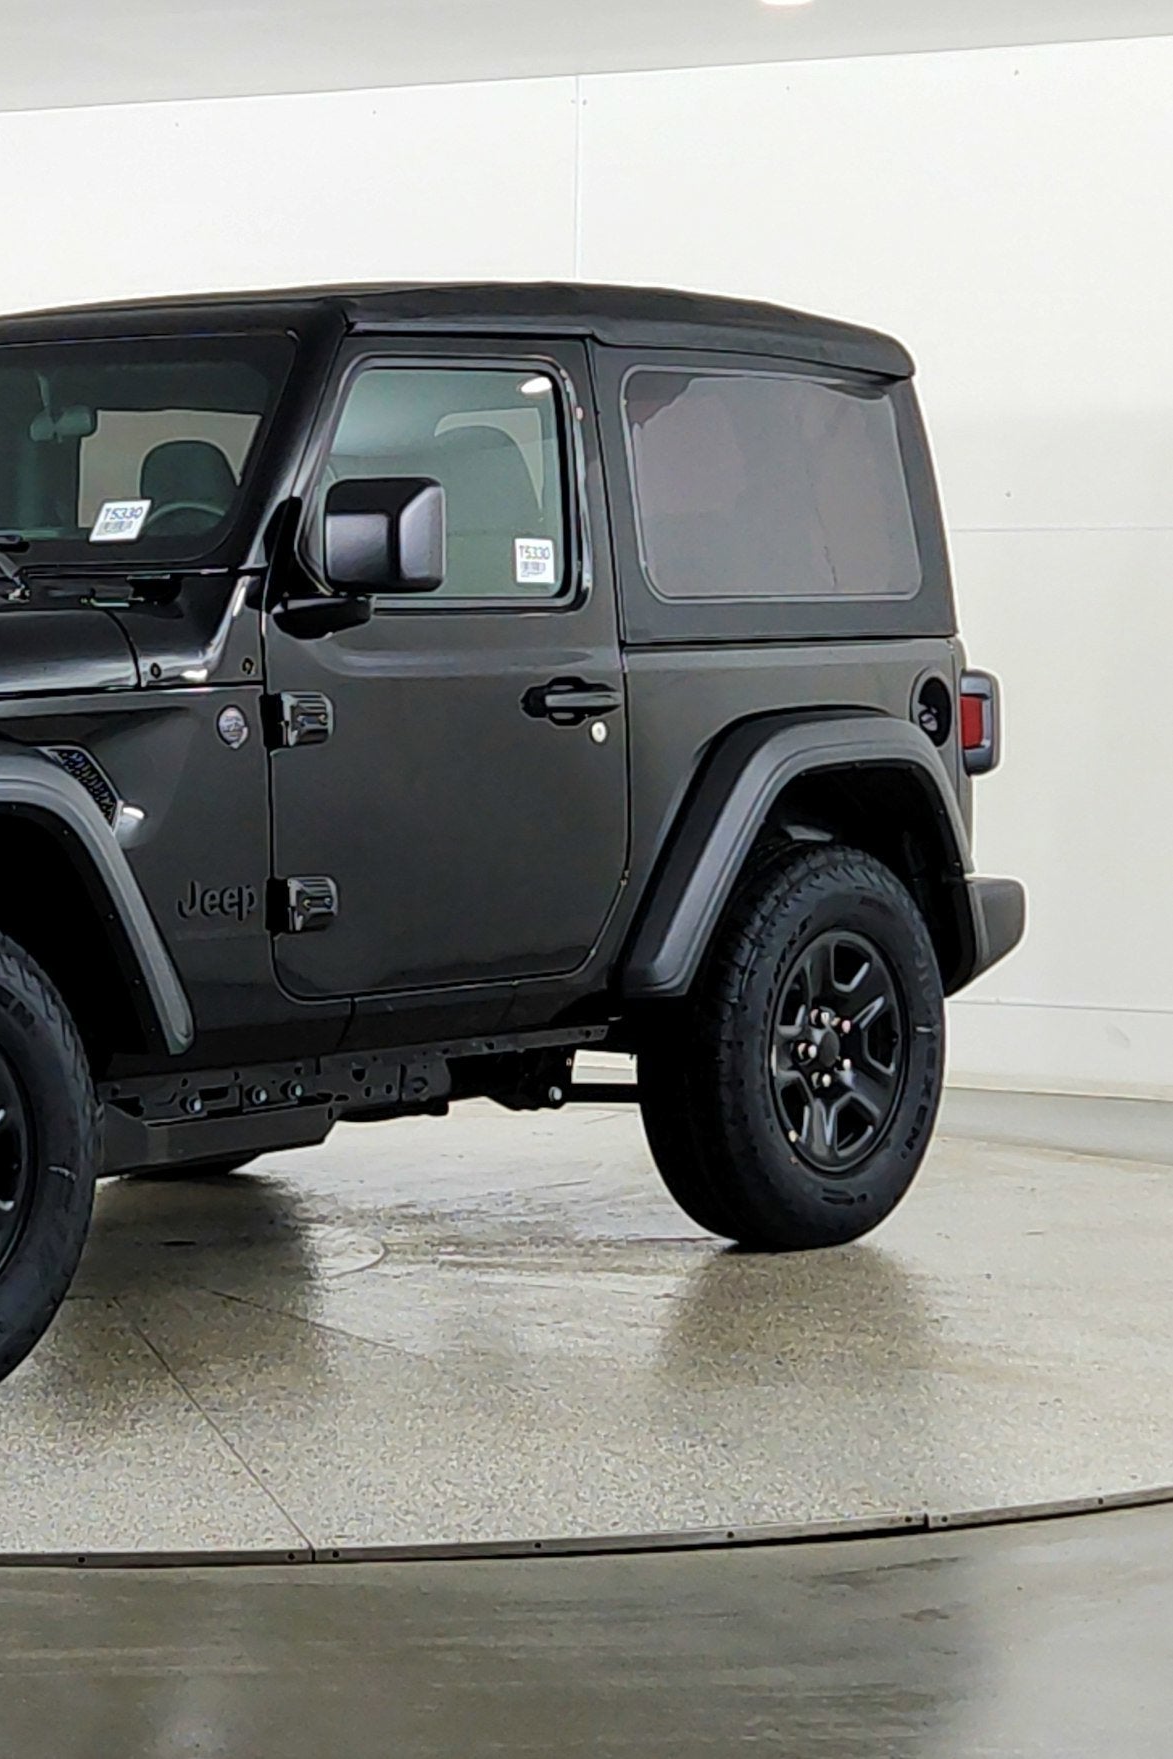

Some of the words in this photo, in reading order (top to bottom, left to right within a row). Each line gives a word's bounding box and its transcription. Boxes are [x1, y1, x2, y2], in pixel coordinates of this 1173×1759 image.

[103, 506, 144, 520] T5330
[518, 544, 551, 560] T5330
[177, 880, 256, 921] Jeep
